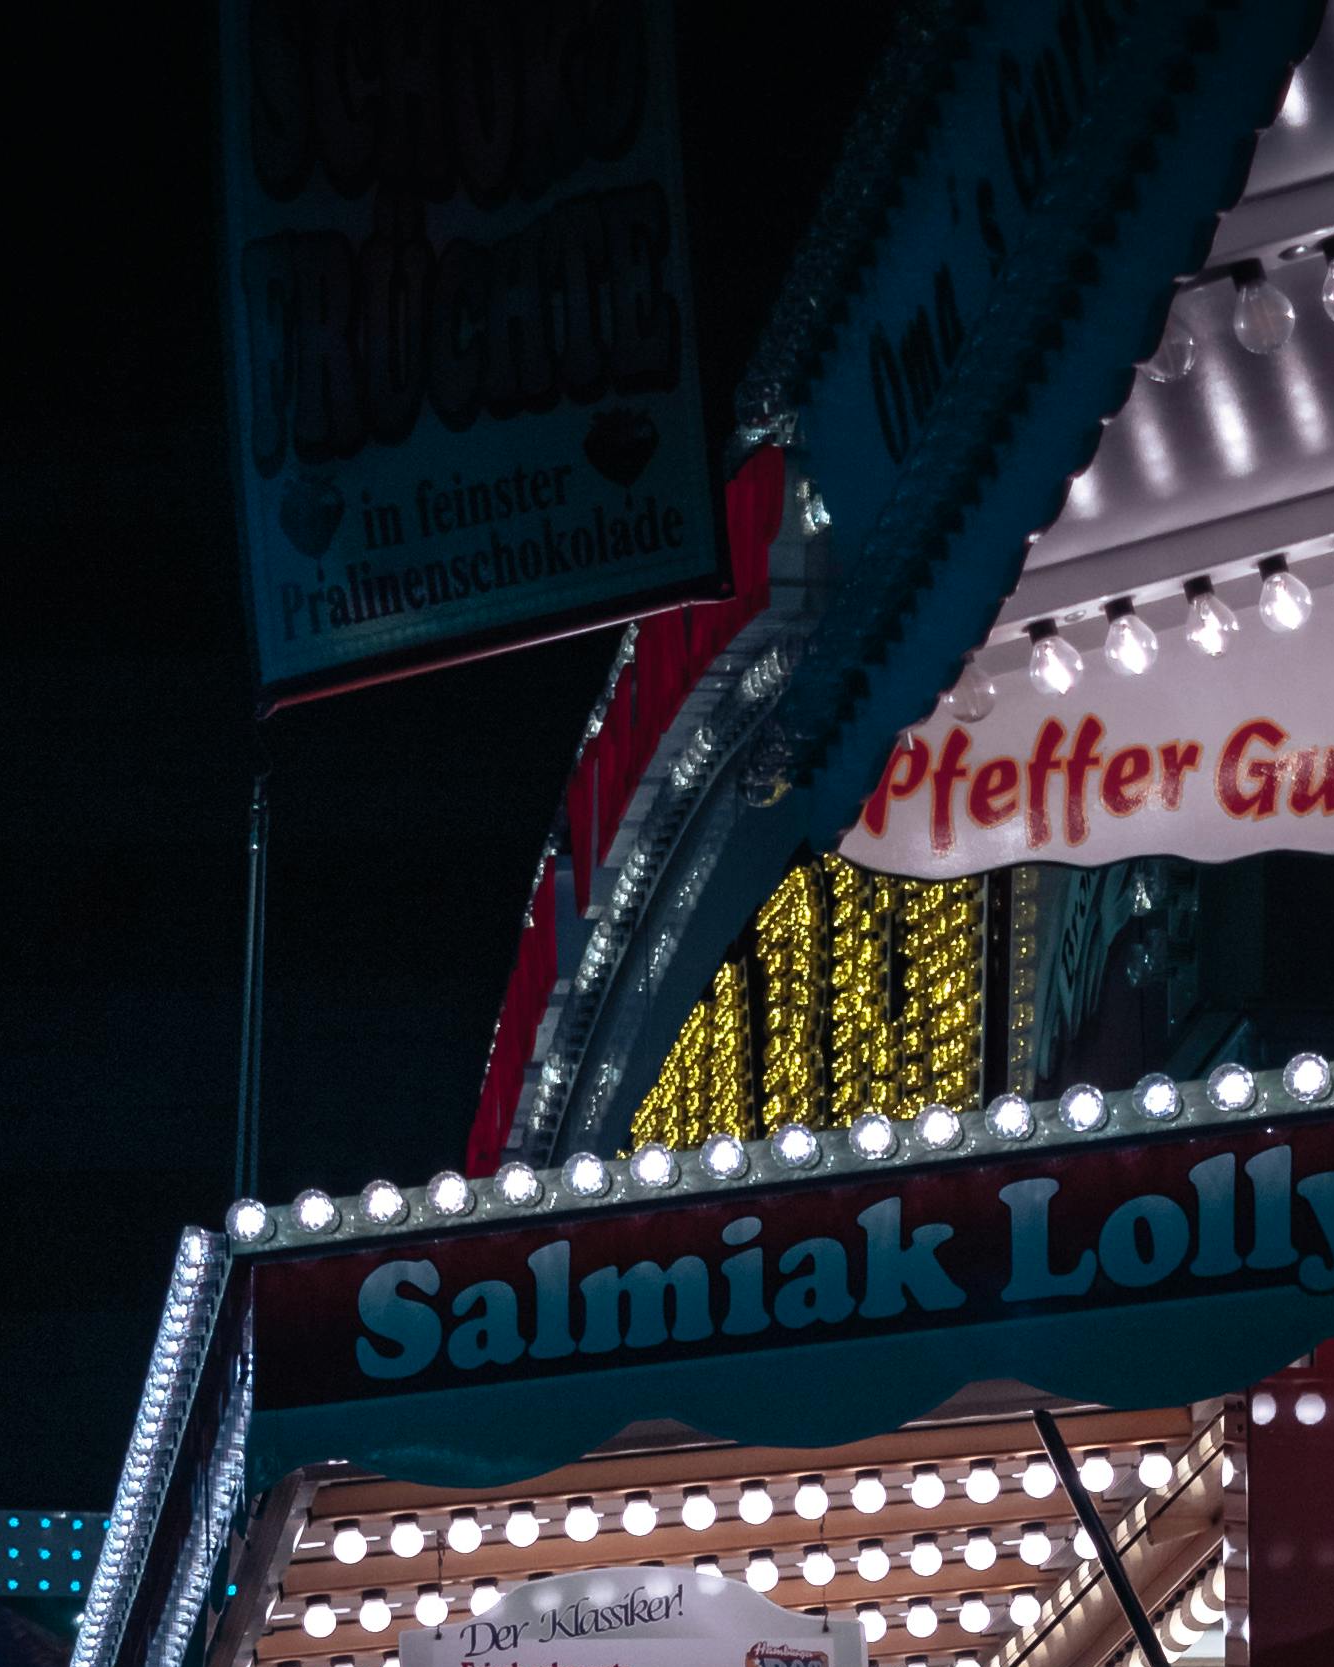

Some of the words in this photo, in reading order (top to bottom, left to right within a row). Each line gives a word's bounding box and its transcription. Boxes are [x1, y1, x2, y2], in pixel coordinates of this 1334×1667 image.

[242, 181, 679, 477] FRÜCHTE
[281, 495, 685, 641] Pralinenschokolade
[358, 486, 402, 551] in
[415, 461, 573, 538] feinster
[865, 715, 1200, 857] Pfeffer
[355, 1197, 968, 1381] Salmiak
[460, 1620, 530, 1658] Der
[538, 1584, 685, 1643] Klassiker!
